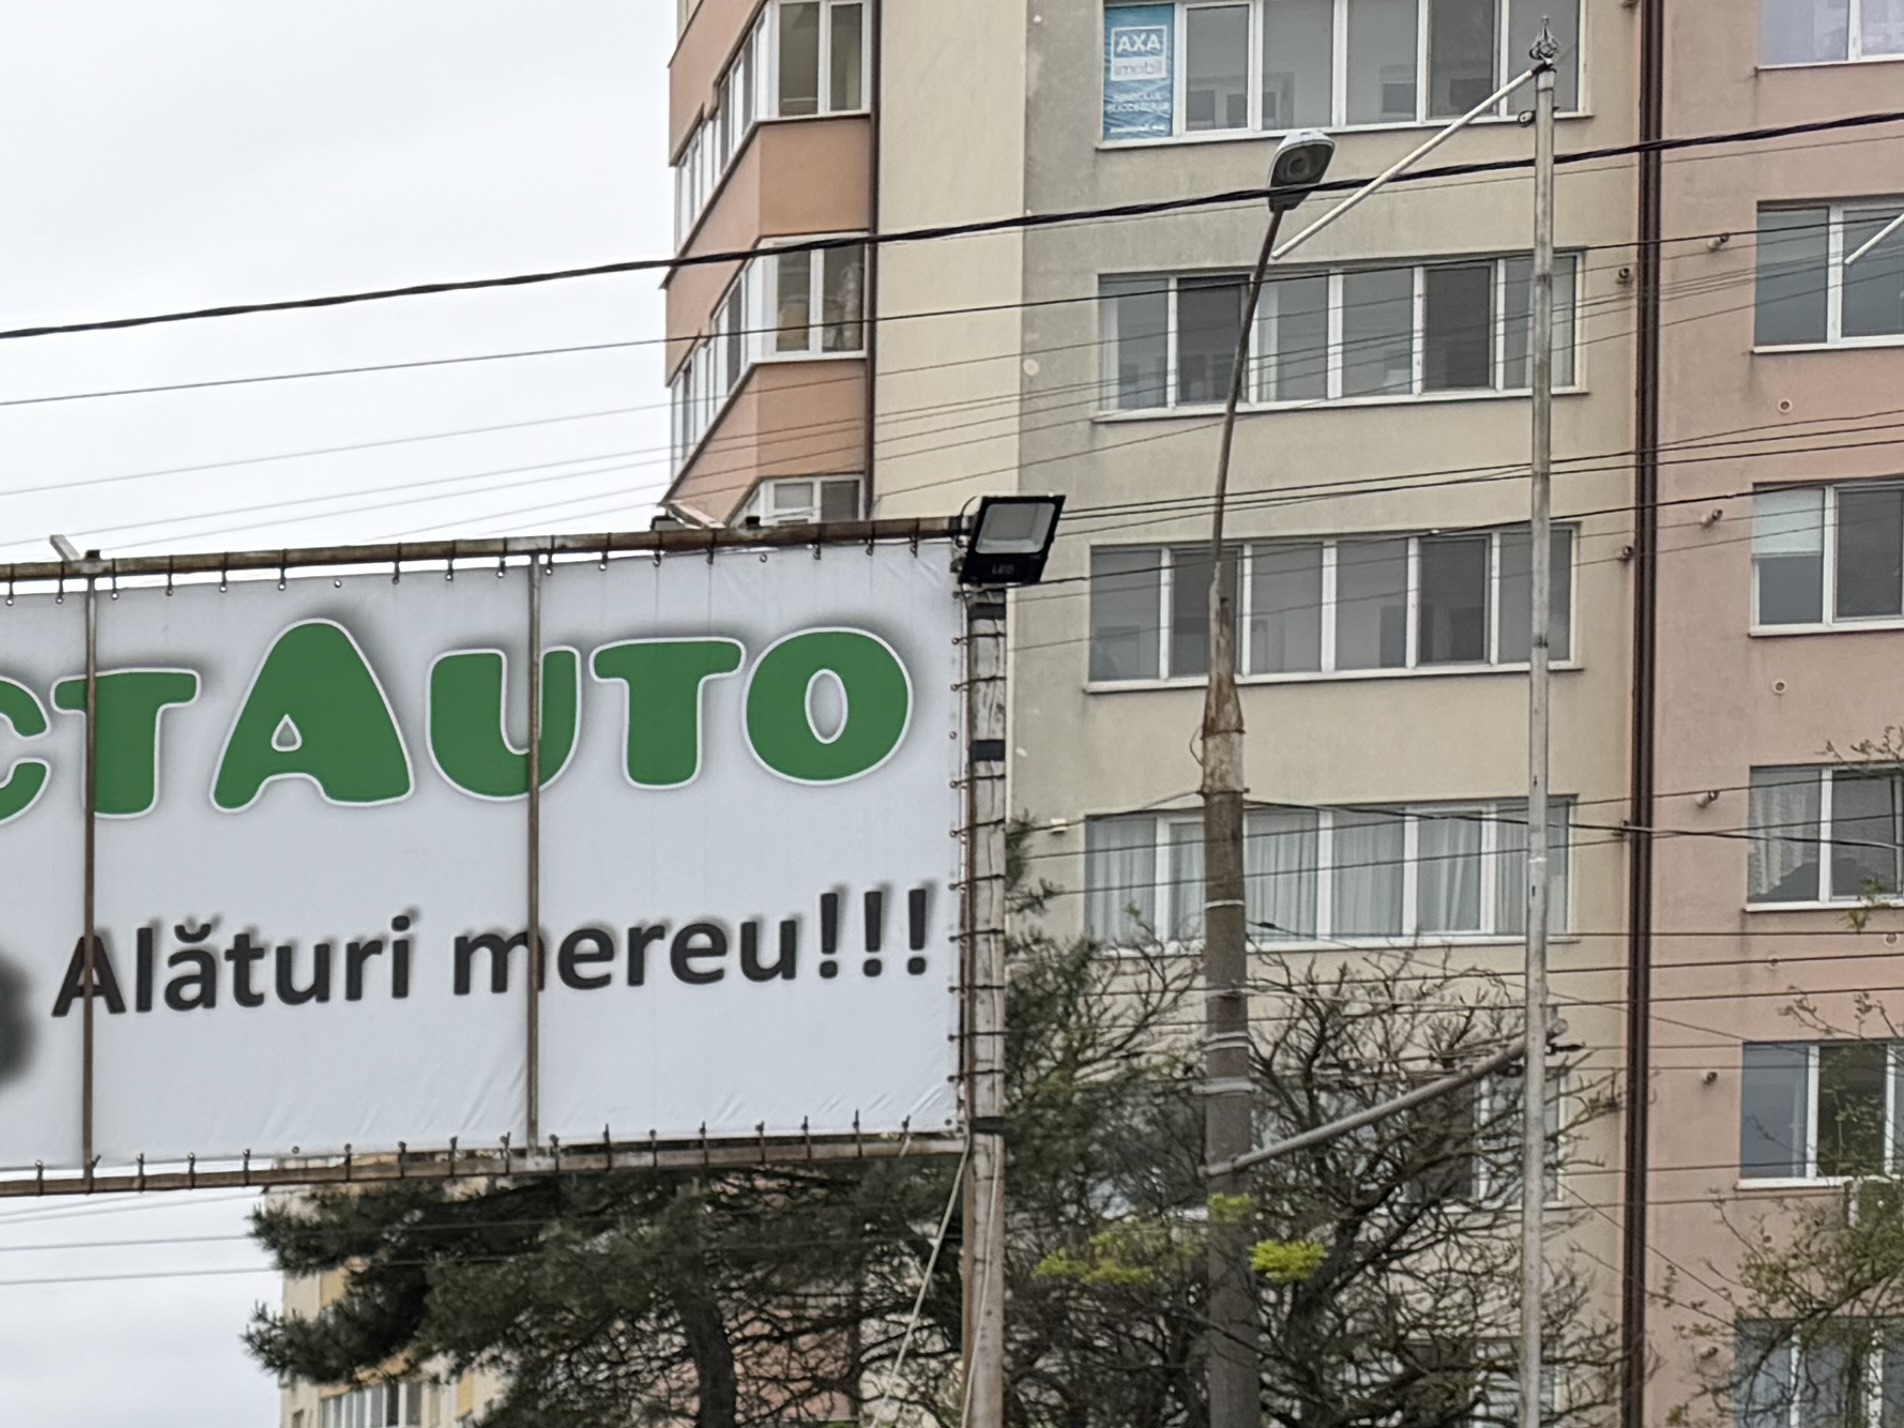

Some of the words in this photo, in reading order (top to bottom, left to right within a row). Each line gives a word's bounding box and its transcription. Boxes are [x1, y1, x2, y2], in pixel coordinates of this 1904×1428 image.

[1116, 33, 1161, 53] AXA
[52, 910, 414, 1017] Alături
[453, 884, 930, 996] mereu!!!
